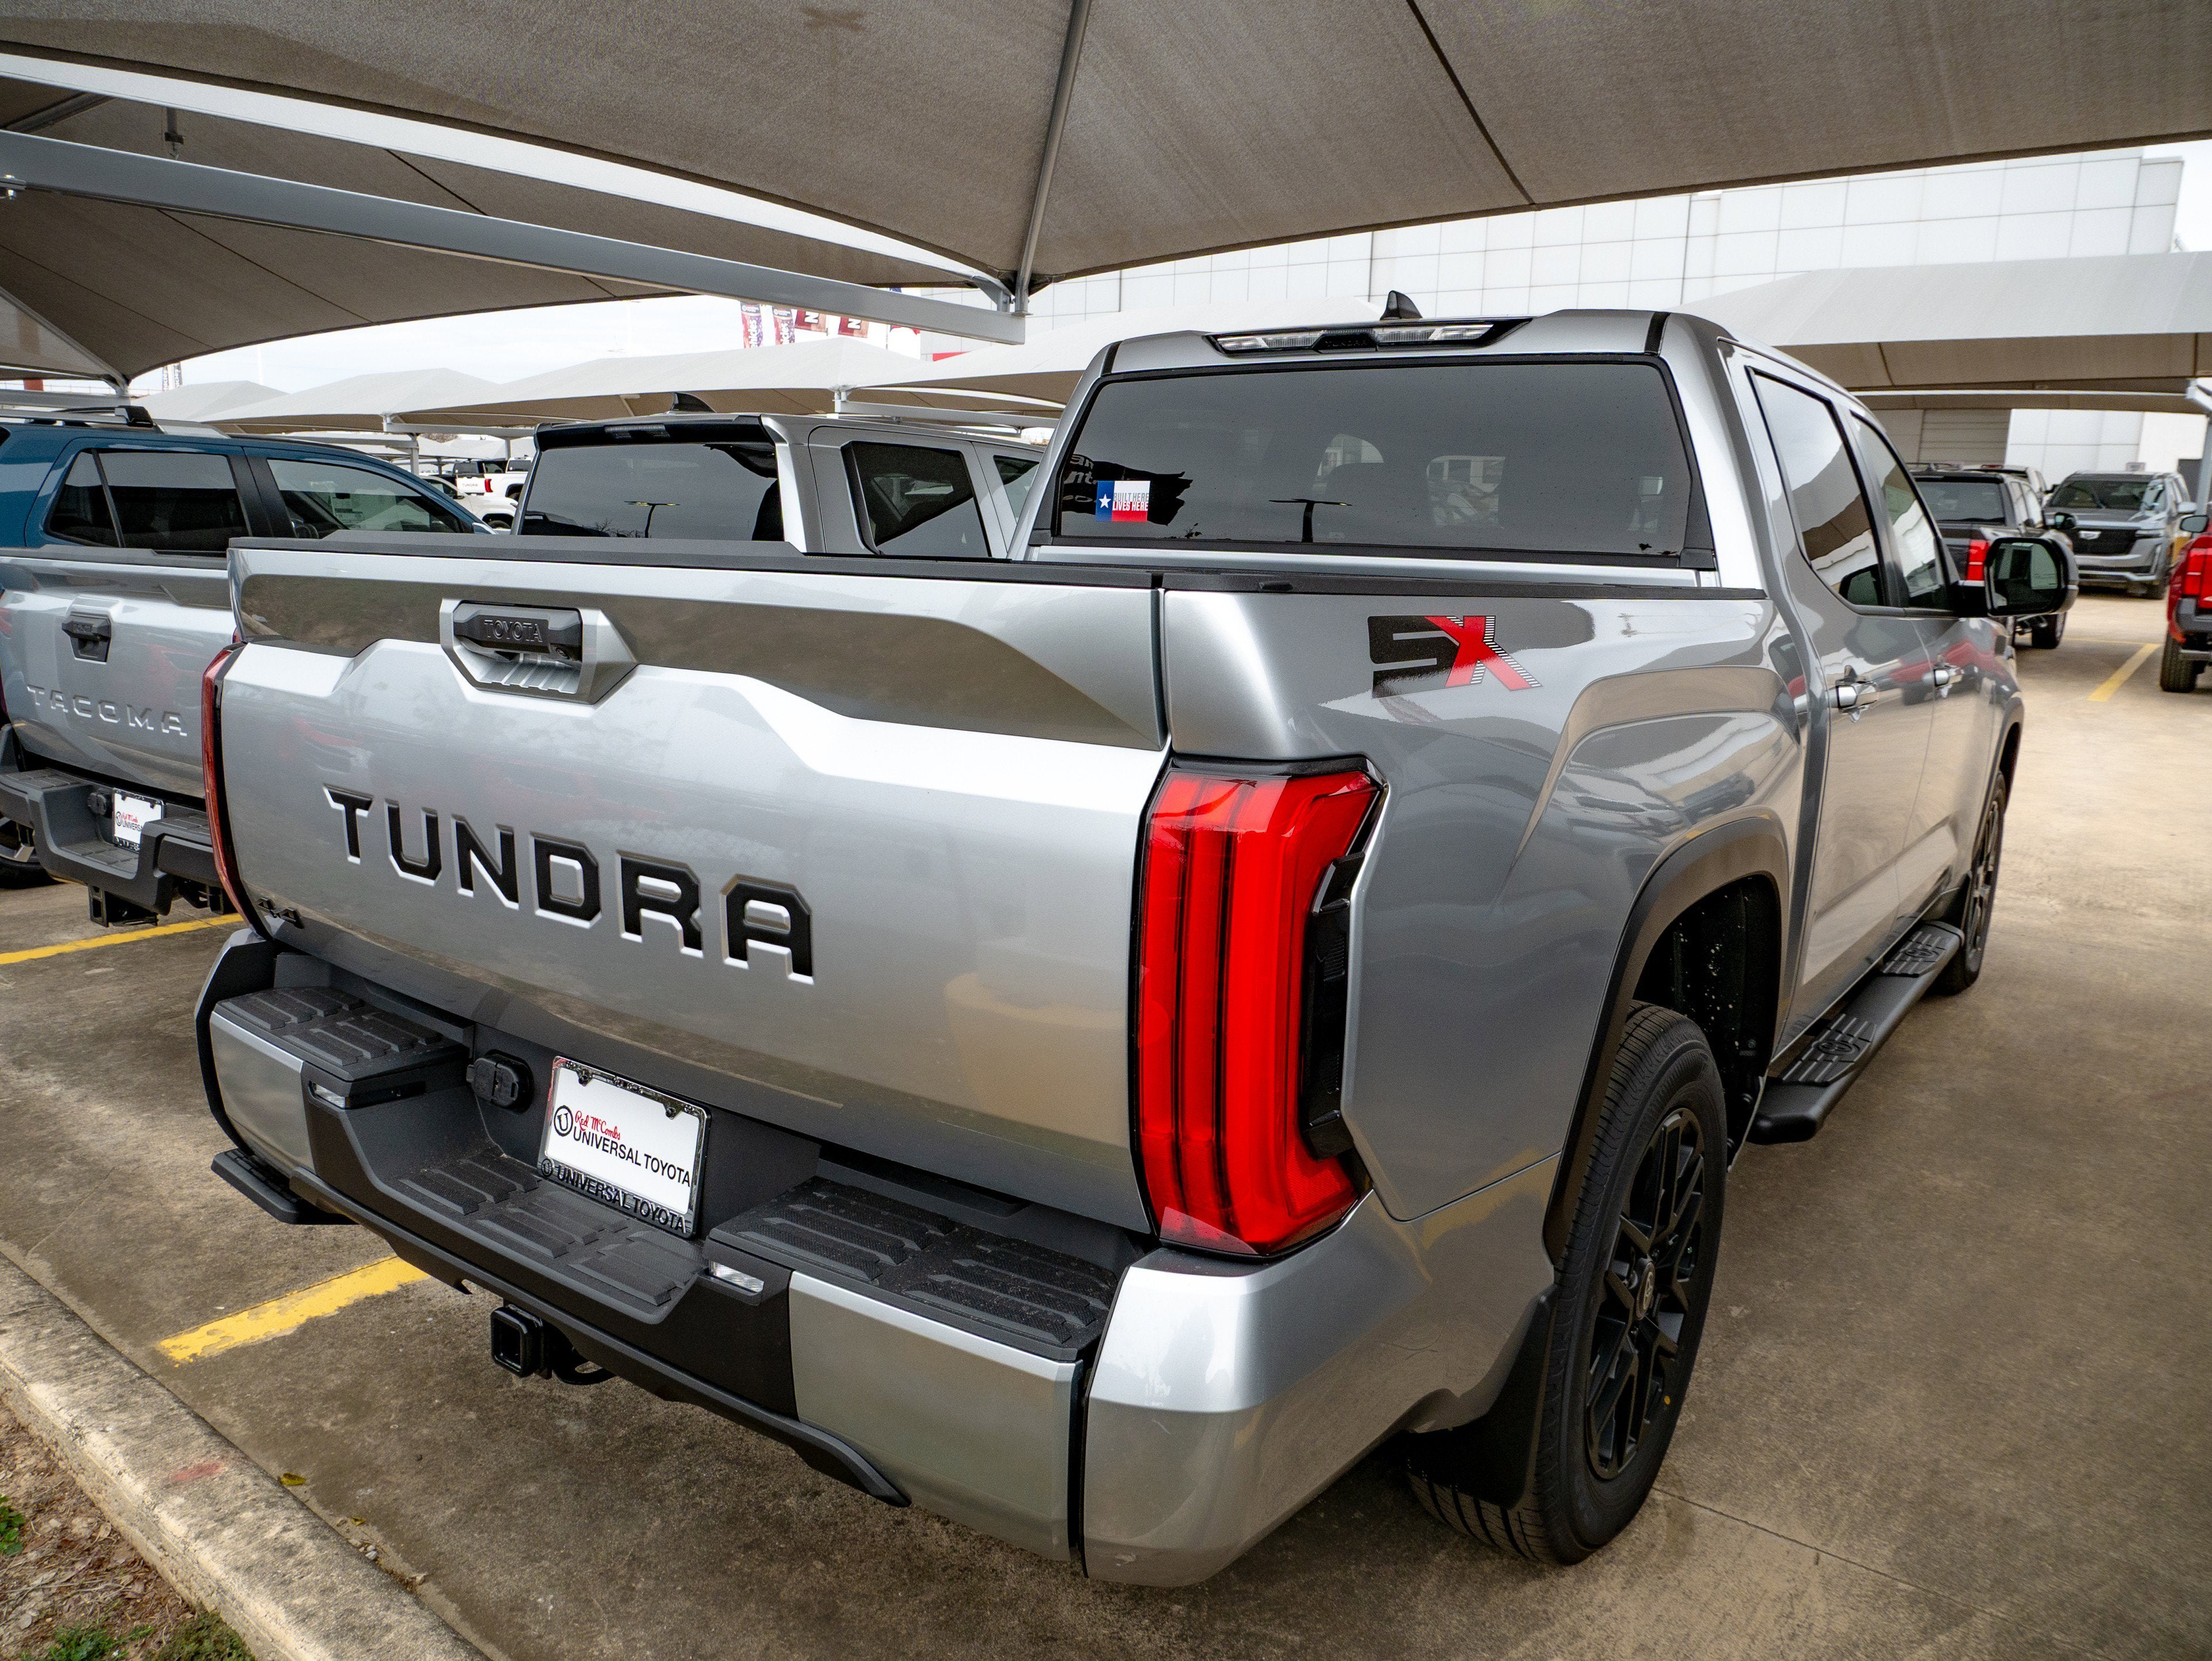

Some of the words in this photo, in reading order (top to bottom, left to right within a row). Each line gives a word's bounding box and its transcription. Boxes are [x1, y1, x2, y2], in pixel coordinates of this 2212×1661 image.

[1112, 501, 1131, 511] LIVES
[1131, 501, 1149, 511] HERE
[1113, 493, 1131, 502] BUILT
[1132, 493, 1149, 502] HERE
[484, 619, 543, 642] TOYOTA
[26, 684, 188, 737] TACOMA
[323, 782, 815, 985] TUNDRA
[575, 1110, 589, 1131] Red
[573, 1126, 642, 1167] UNIVERSAL
[643, 1153, 691, 1187] TOYOTA
[557, 1163, 631, 1209] UNIVERSAL
[632, 1194, 687, 1234] TOYOTA
